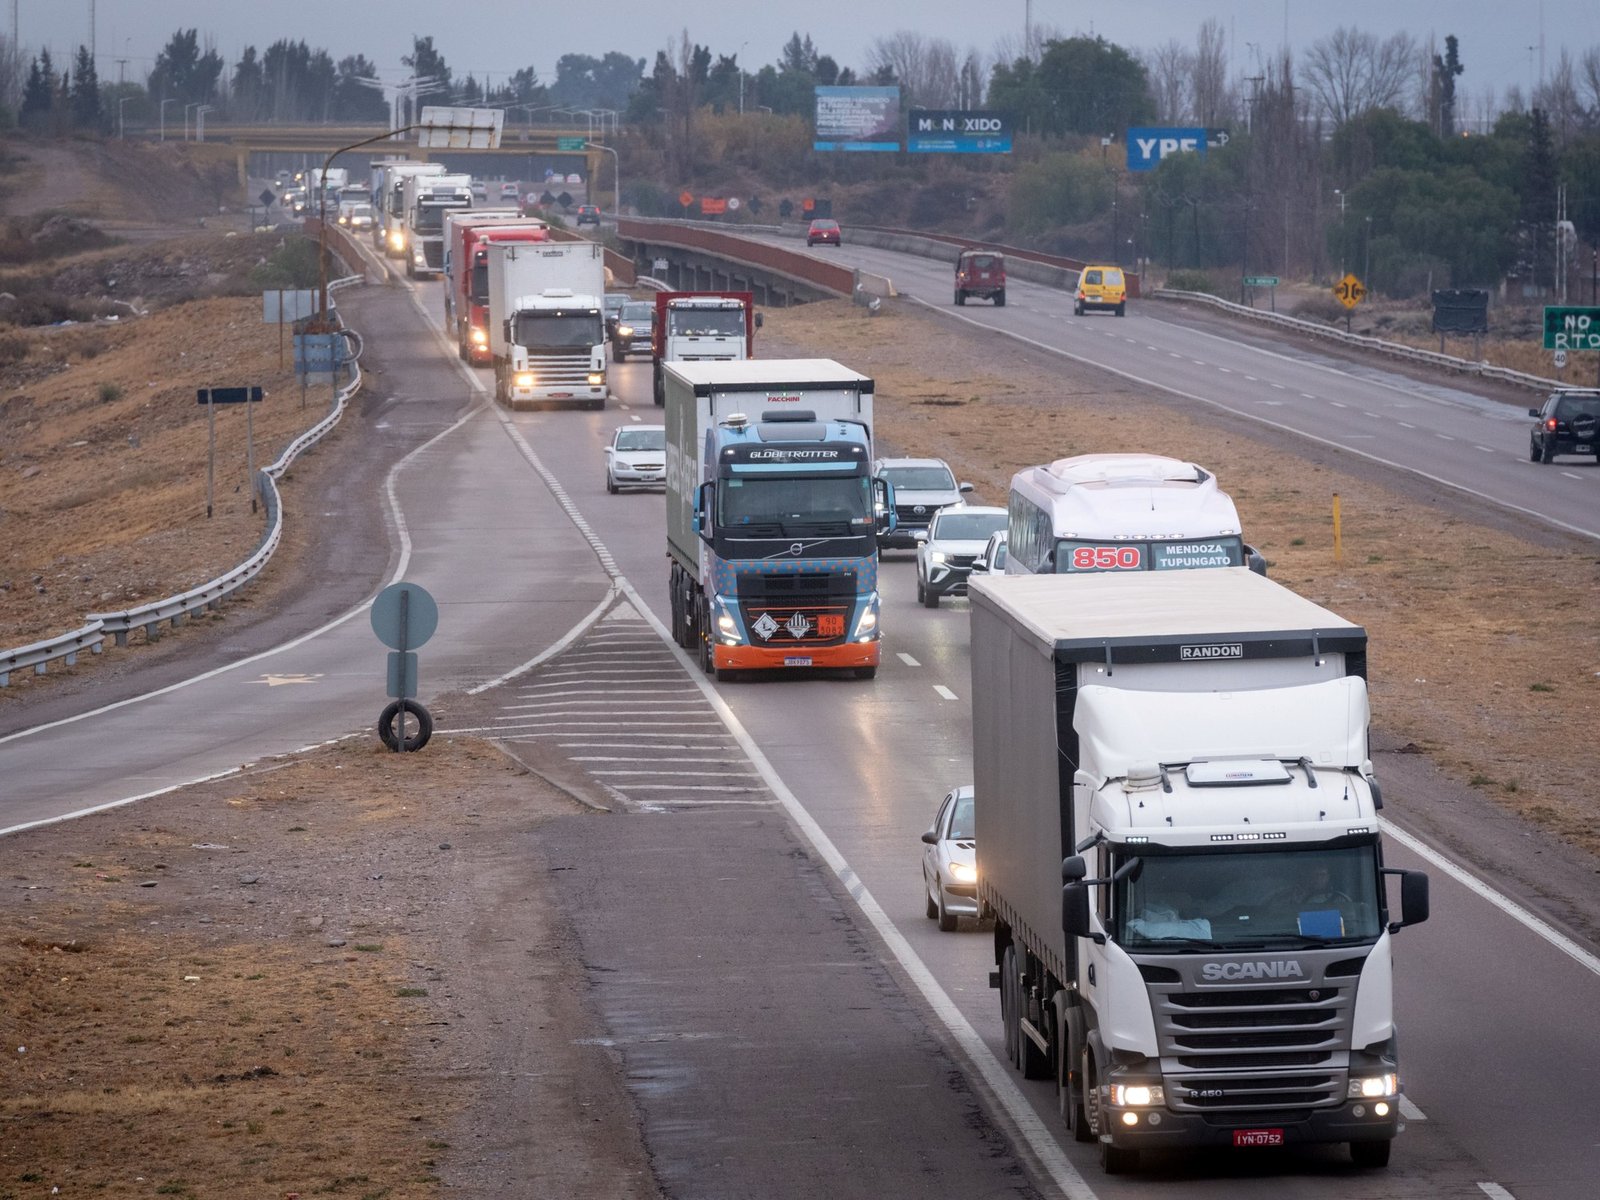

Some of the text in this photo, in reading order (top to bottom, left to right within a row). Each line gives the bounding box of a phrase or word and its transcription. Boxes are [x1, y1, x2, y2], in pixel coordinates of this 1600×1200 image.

[1565, 315, 1591, 329] NO
[1555, 354, 1566, 362] 40
[750, 450, 839, 459] GLOBETROTTER
[1166, 545, 1223, 555] MENDOZA
[1073, 547, 1141, 569] 850
[1160, 556, 1231, 567] TUPUNGATO
[825, 616, 837, 625] 90
[1183, 646, 1241, 658] RANDON
[1202, 961, 1303, 980] SCANIA
[1191, 1089, 1223, 1098] R 450
